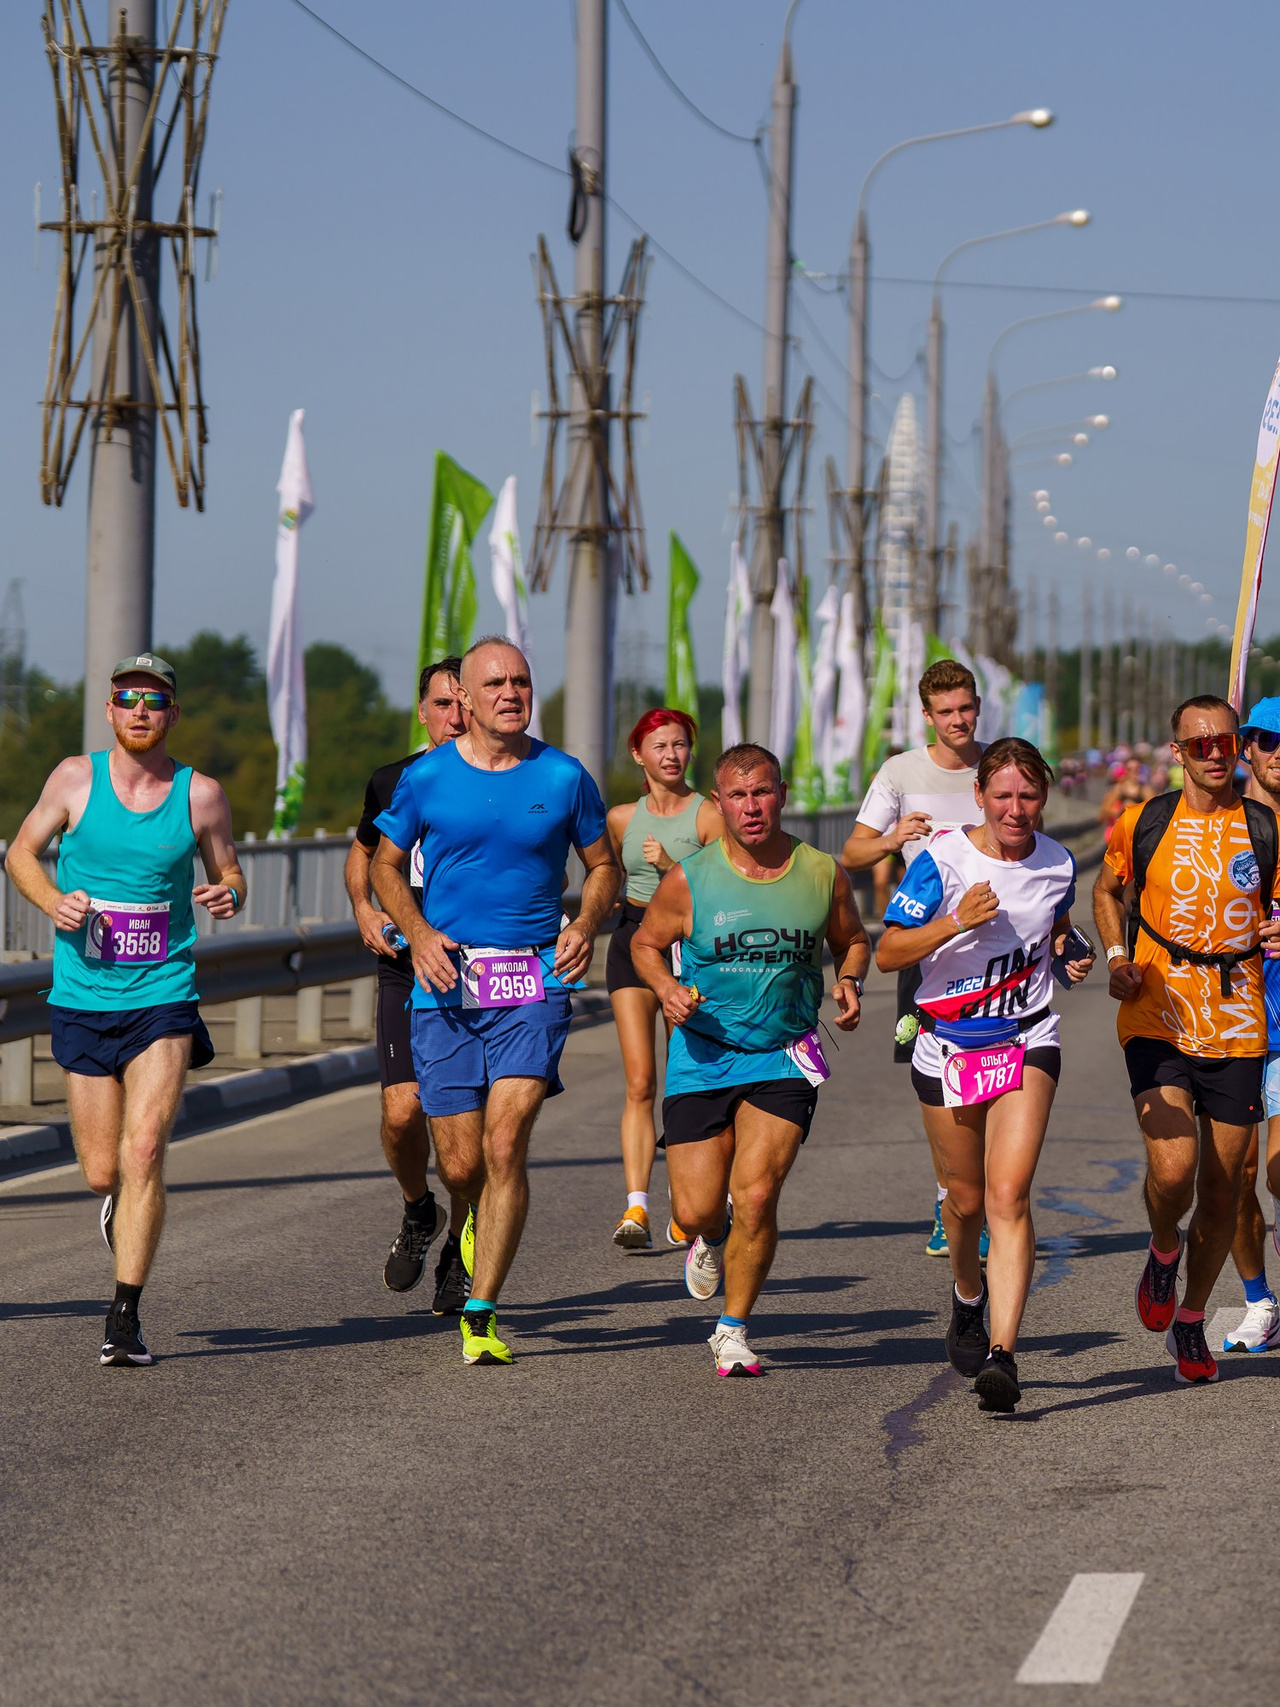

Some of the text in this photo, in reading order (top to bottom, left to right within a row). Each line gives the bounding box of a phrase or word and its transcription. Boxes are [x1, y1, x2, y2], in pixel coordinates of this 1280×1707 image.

[891, 891, 927, 919] ПСБ
[129, 919, 151, 930] ИВАН
[114, 931, 161, 956] 3558
[491, 961, 528, 973] НИКОЛАЙ
[489, 975, 537, 1000] 2959
[946, 975, 984, 996] 2022
[980, 1053, 1009, 1067] ОЛЬГА
[973, 1062, 1017, 1096] 1787
